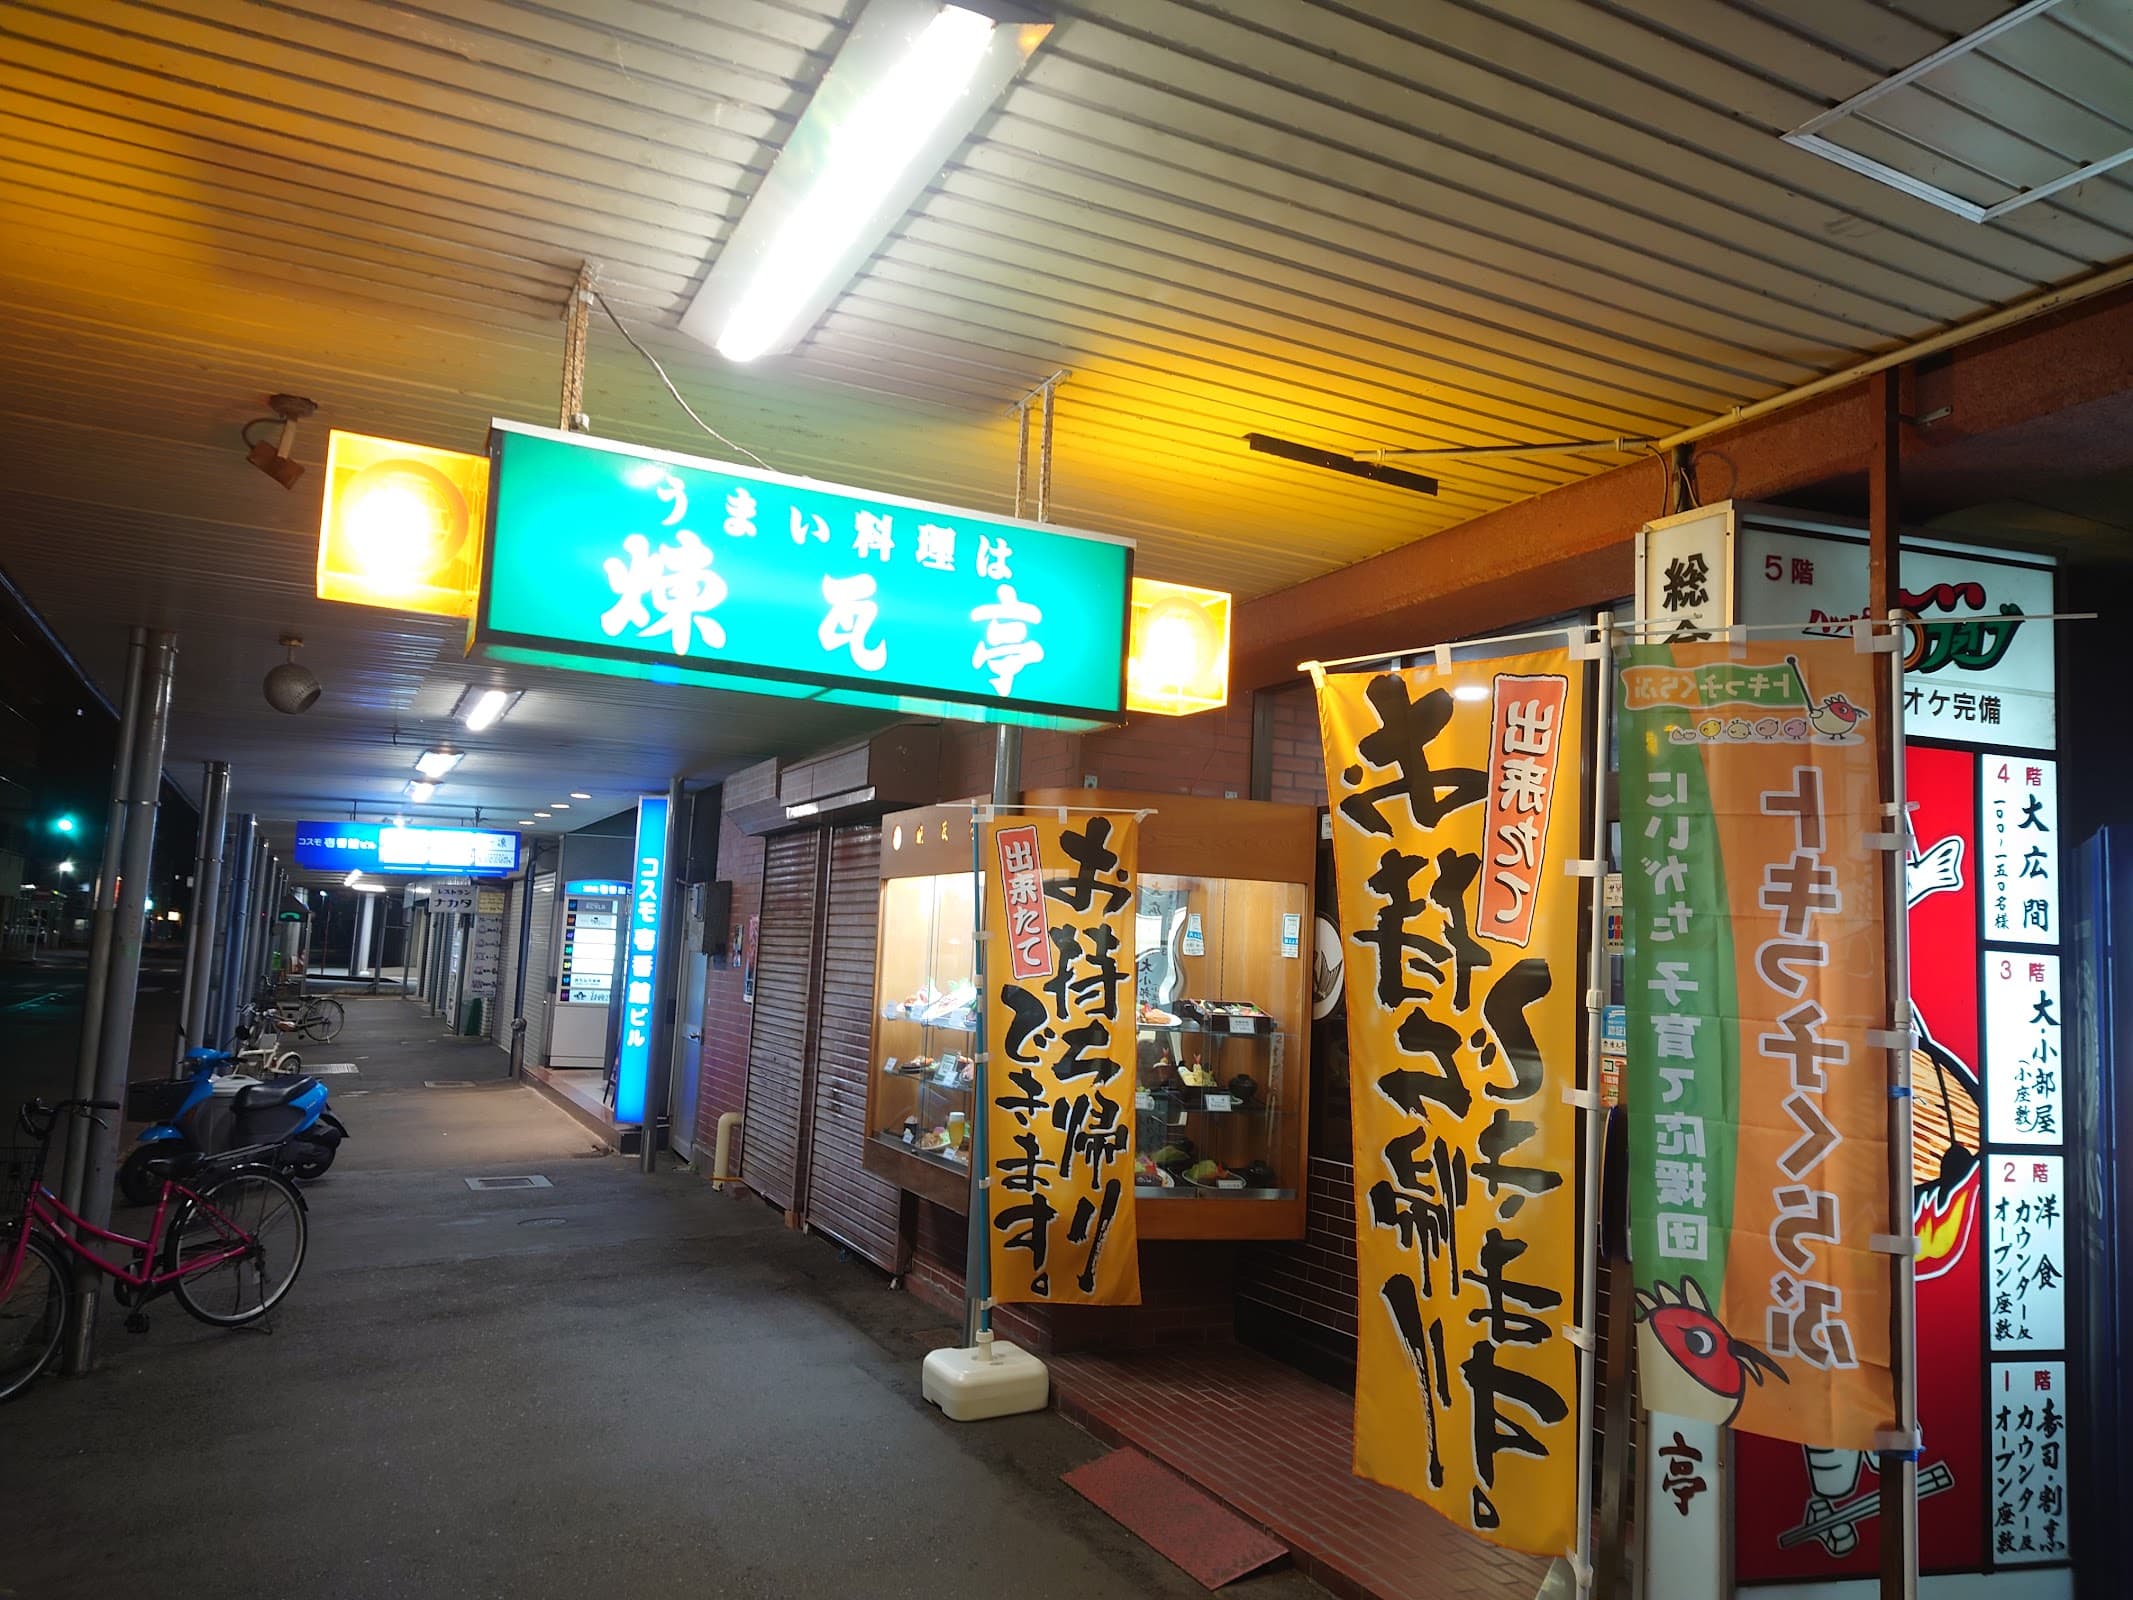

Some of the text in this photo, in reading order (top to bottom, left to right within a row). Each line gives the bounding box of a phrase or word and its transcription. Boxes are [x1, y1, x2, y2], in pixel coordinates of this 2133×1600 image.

[654, 476, 1014, 580] うまい料理は
[1765, 554, 1815, 586] 5階
[600, 531, 1045, 698] 煉瓦亭
[1997, 763, 2043, 787] 4階
[1003, 841, 1042, 969] 出来たて
[2017, 794, 2050, 931] 大広間
[2000, 960, 2046, 983] 3階
[1043, 816, 1133, 1294] お持ち帰り
[994, 984, 1058, 1297] できます。
[2003, 1162, 2049, 1184] 2階
[2031, 1193, 2063, 1291] 洋食
[1657, 1431, 1708, 1517] 亭
